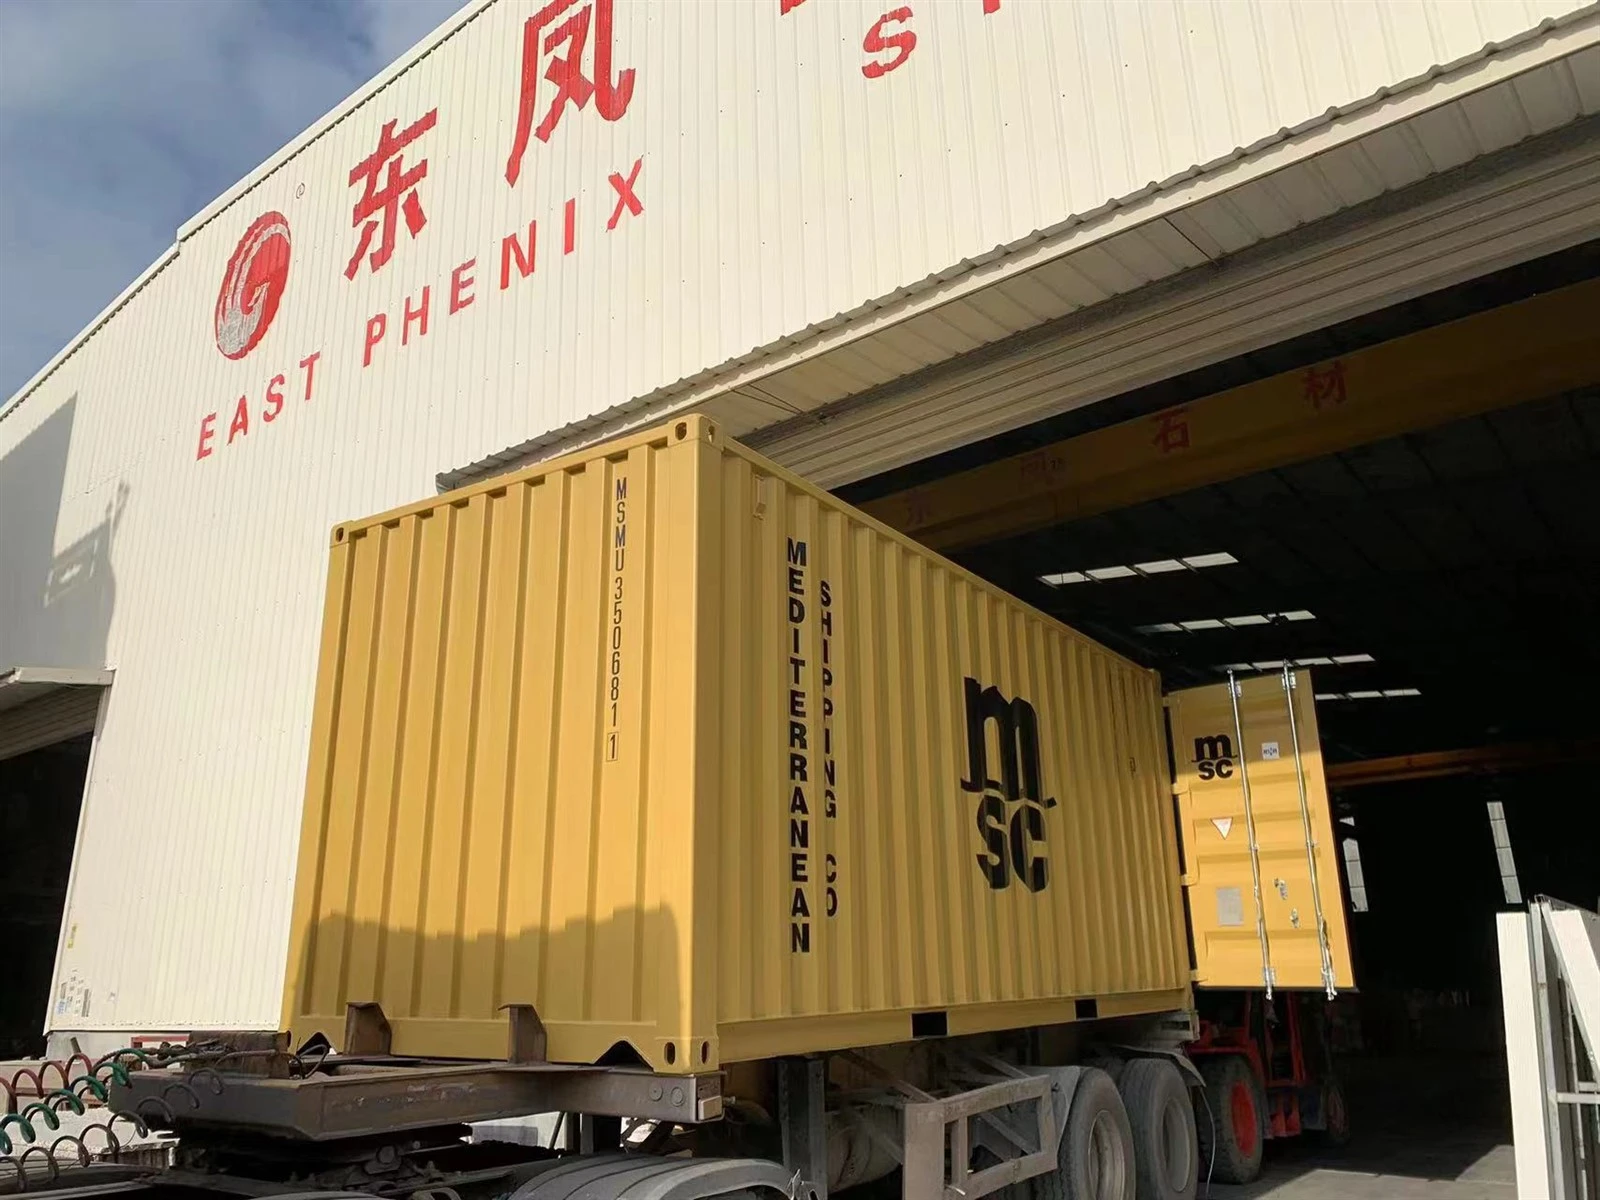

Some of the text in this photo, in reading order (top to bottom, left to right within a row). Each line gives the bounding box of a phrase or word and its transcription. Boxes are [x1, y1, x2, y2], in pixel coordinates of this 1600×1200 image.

[196, 352, 321, 461] EAST
[363, 153, 645, 368] PHENIX
[615, 476, 628, 571] MSMU
[610, 576, 623, 727] 350681
[787, 536, 811, 953] MEDITERRANEAN
[819, 580, 838, 819] SHIPPING
